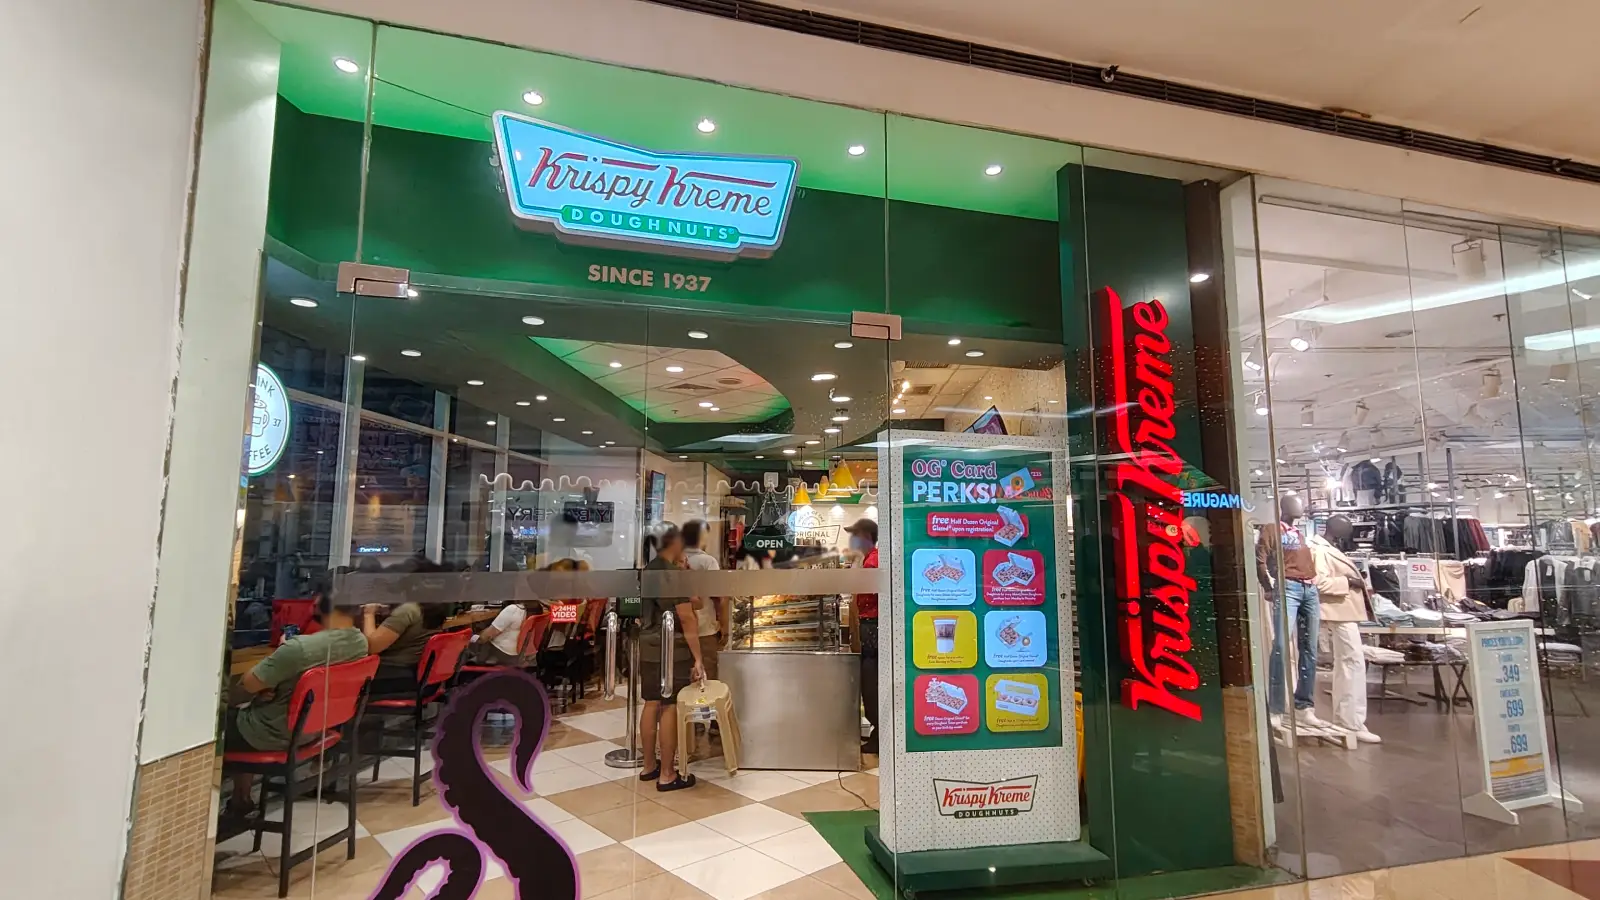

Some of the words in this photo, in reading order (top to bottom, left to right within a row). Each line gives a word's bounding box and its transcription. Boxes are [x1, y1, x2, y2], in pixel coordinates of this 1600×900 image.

[528, 147, 660, 208] Krispy
[657, 166, 777, 216] Kreme
[588, 264, 654, 287] SINCE
[663, 272, 712, 292] 1937
[1105, 285, 1184, 500] Kreme
[950, 460, 998, 479] Card
[912, 481, 997, 504] PERKS!
[932, 515, 949, 525] free
[979, 519, 999, 527] Original
[756, 539, 784, 549] OPEN
[1117, 491, 1202, 721] Krispy
[1502, 664, 1520, 683] 349
[1506, 699, 1524, 718] 699
[1510, 734, 1528, 753] 699
[942, 787, 989, 808] Krispy
[988, 785, 1032, 805] Kreme
[958, 809, 1014, 818] DOUGHNUTS
